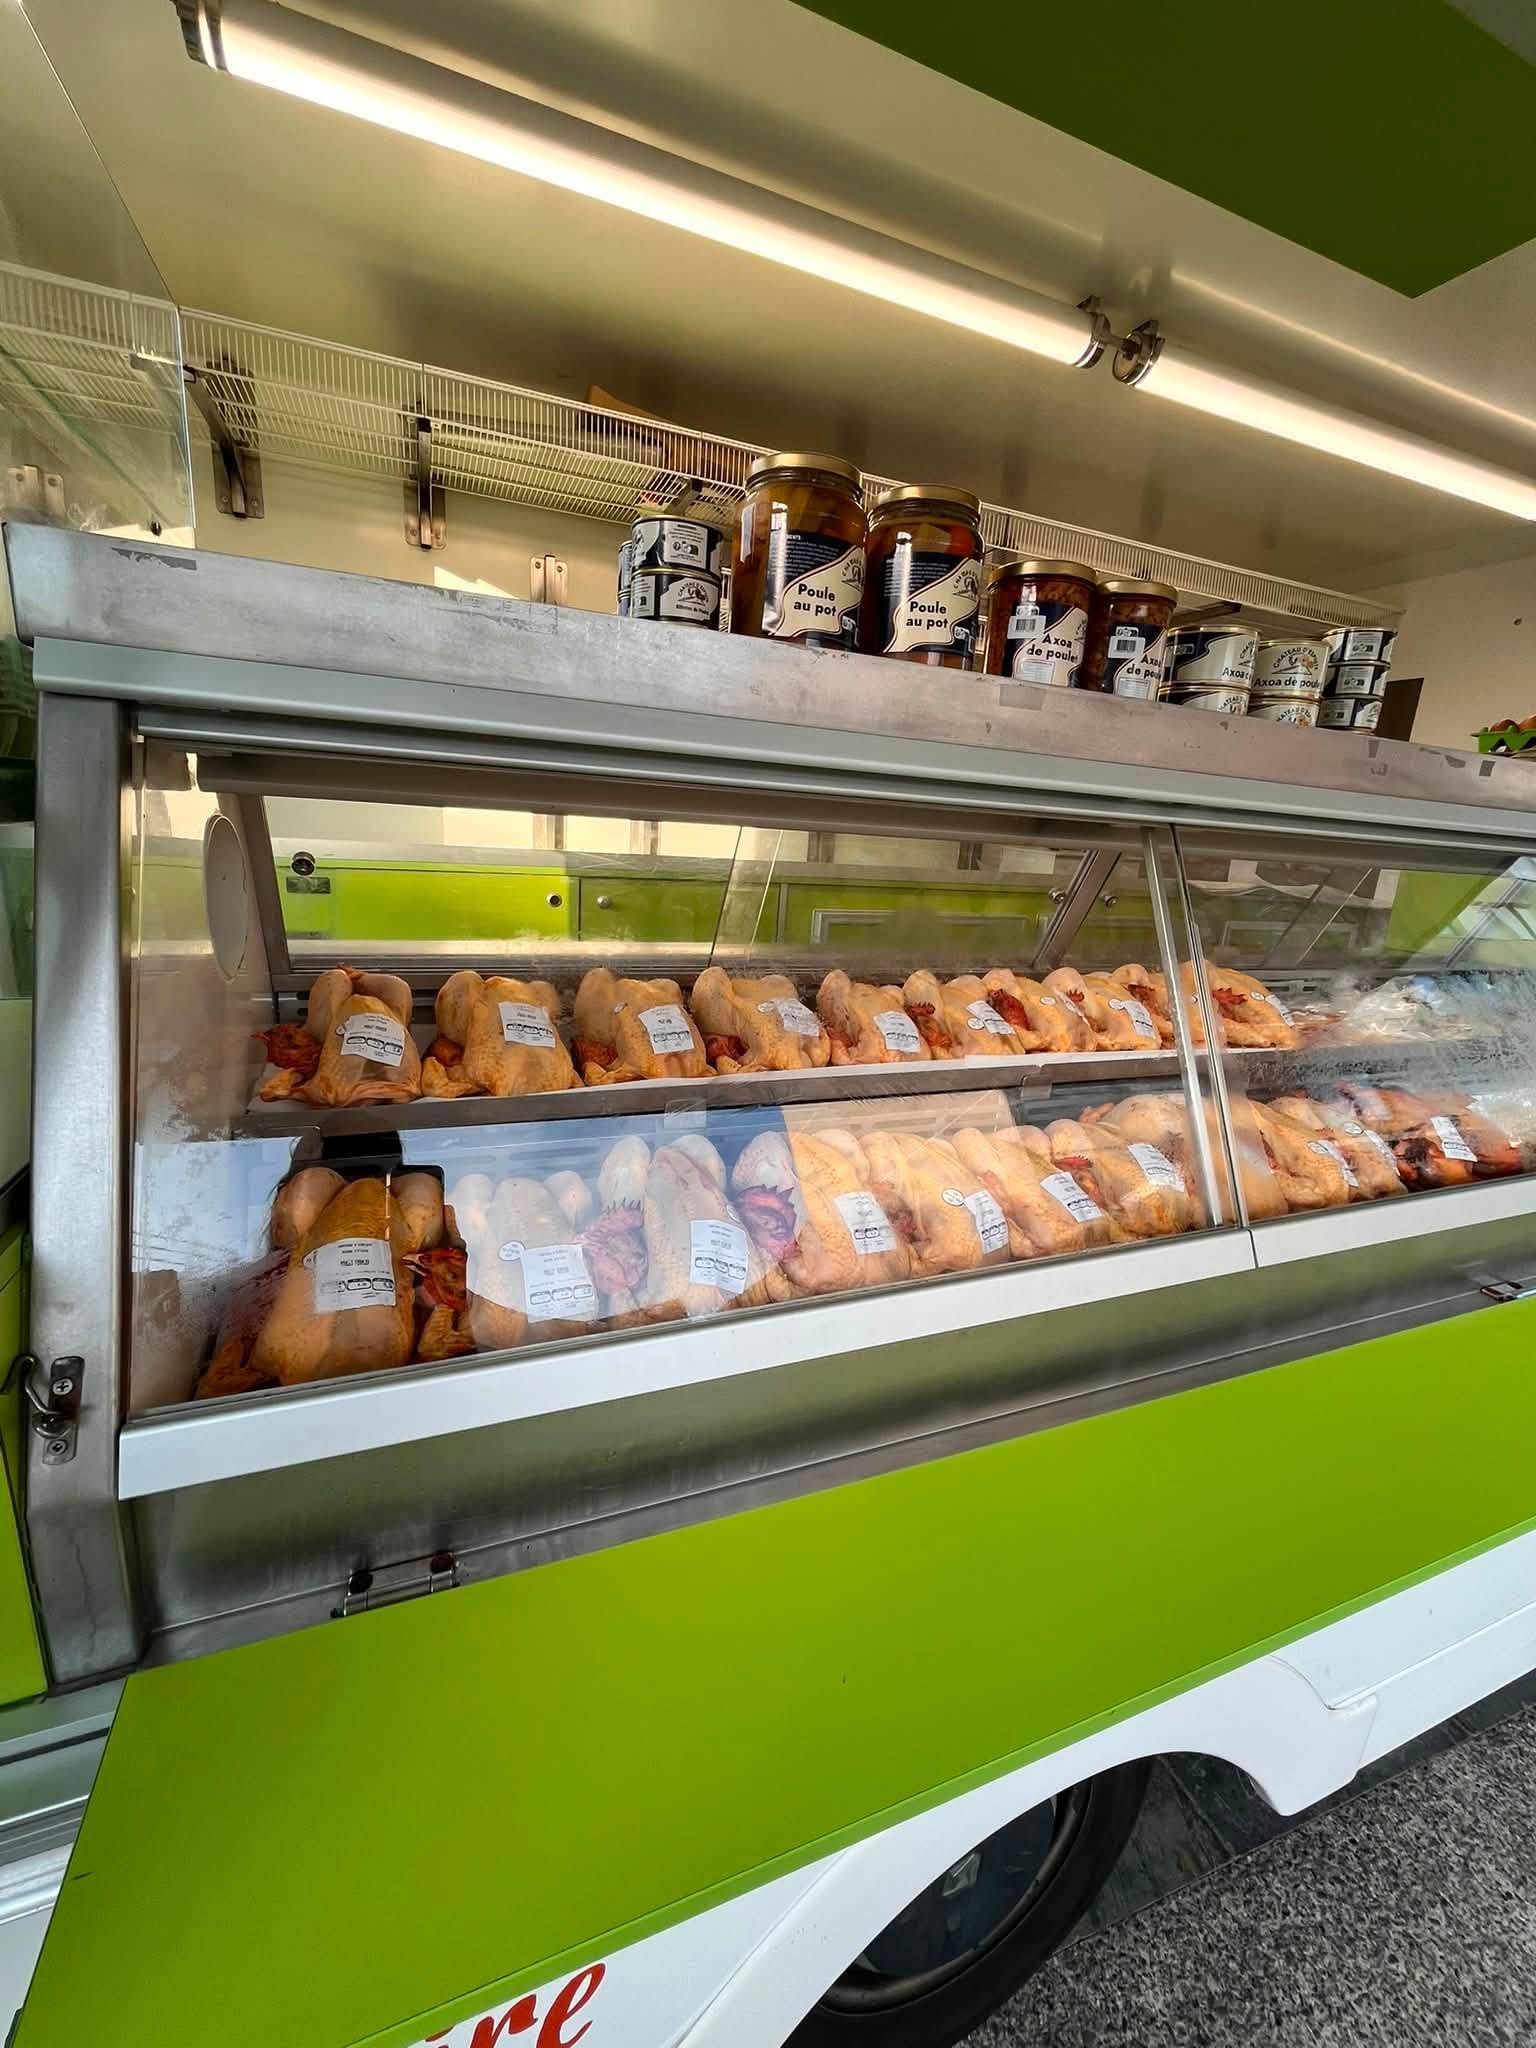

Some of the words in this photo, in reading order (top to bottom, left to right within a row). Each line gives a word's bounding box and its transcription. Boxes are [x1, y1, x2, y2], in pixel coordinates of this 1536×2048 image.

[798, 583, 836, 601] Poule
[793, 601, 811, 611] au
[815, 603, 837, 616] pot
[910, 601, 947, 614] Poule
[906, 618, 922, 627] au
[926, 618, 949, 631] pot
[1042, 633, 1073, 648] Axoa
[1026, 644, 1043, 656] de
[1126, 664, 1141, 675] de
[1222, 667, 1245, 678] Axoa
[1254, 677, 1282, 687] Axoa
[1284, 676, 1298, 687] de
